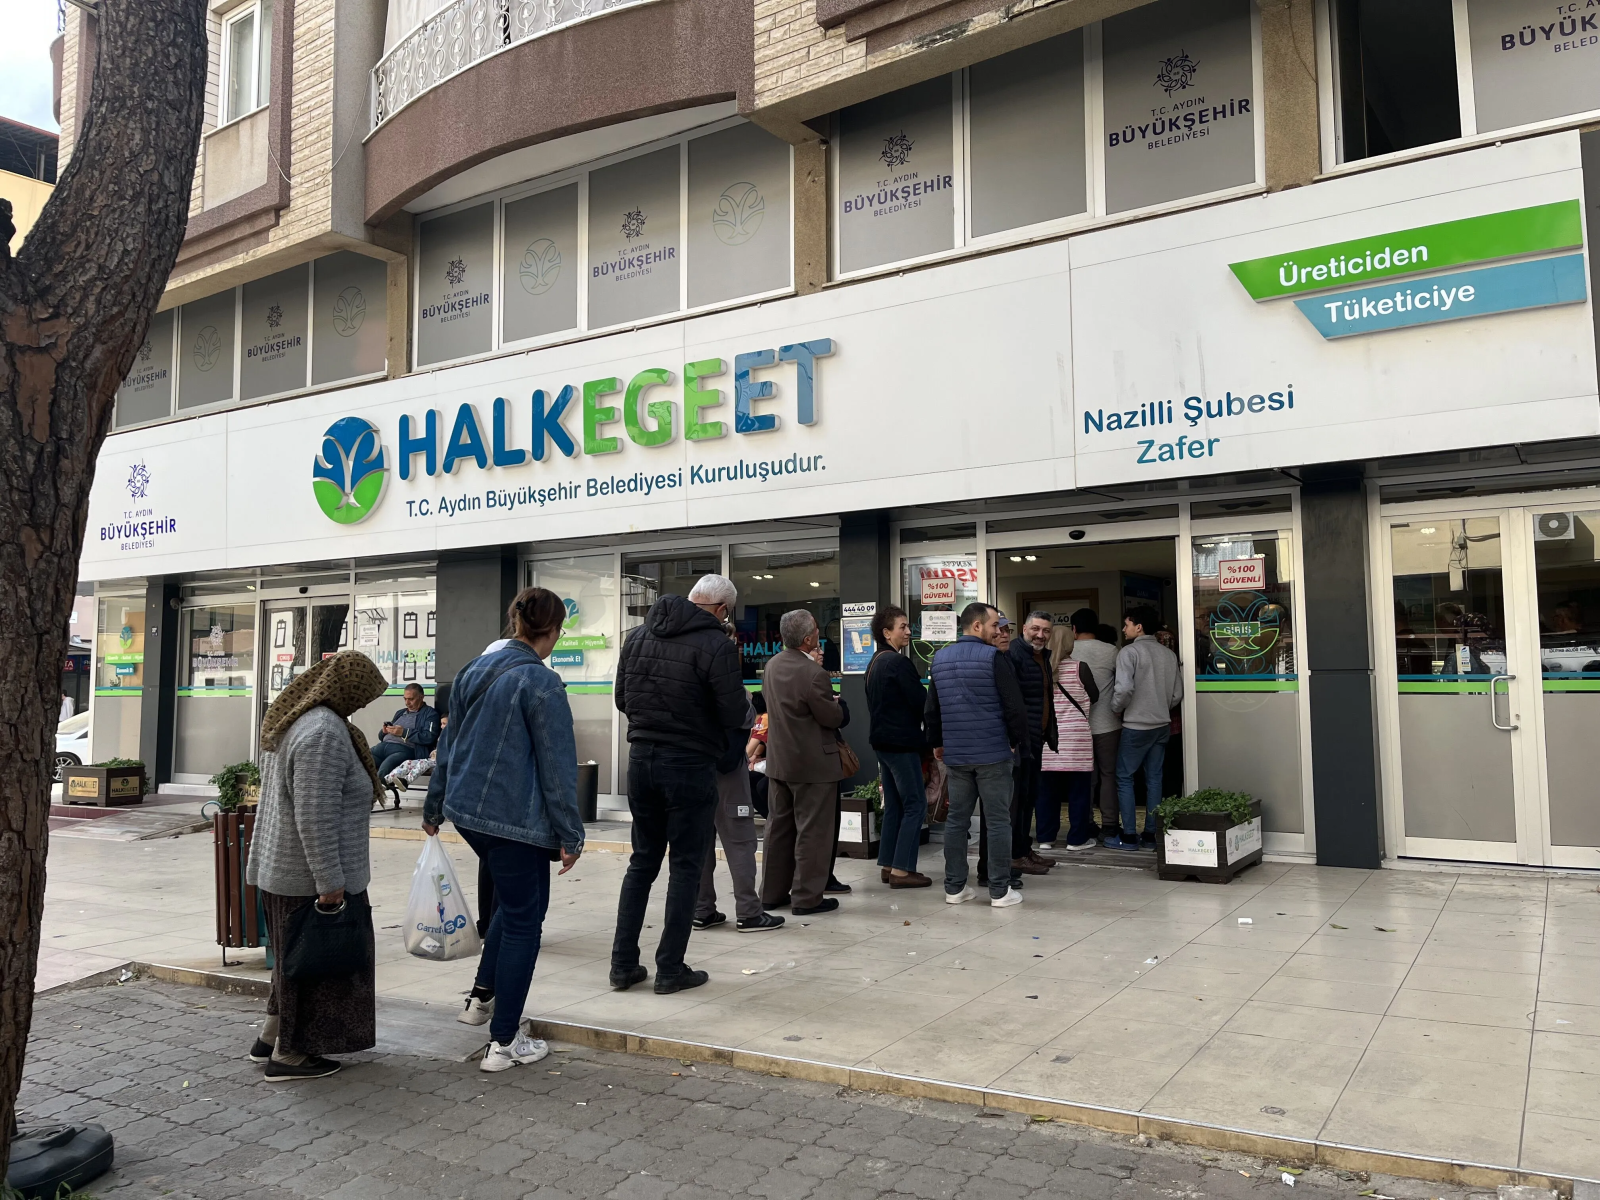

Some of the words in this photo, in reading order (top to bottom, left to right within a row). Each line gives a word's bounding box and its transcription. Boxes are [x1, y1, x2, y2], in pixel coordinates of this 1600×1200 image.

[1556, 3, 1581, 15] T.C.
[1501, 13, 1599, 51] BÜYÜK
[1554, 35, 1599, 53] BELED
[1151, 106, 1169, 117] T.C.
[1173, 96, 1205, 111] AYDIN
[1109, 98, 1251, 147] BÜYÜKŞEHİR
[1148, 126, 1210, 150] BELEDİYESİ
[877, 179, 891, 188] T.C.
[893, 172, 918, 185] AYDIN
[844, 174, 953, 214] BÜYÜKŞEHİR
[873, 198, 922, 217] BELEDİYESİ
[631, 243, 650, 253] AYDIN
[593, 246, 676, 278] BÜYÜKŞEHİR
[1279, 245, 1428, 287] Üreticiden
[615, 266, 652, 281] BELEDİYESİ
[453, 289, 469, 298] AYDIN
[422, 292, 490, 319] BÜYÜKŞEHİR
[1324, 284, 1475, 323] Tüketiciye
[440, 310, 471, 323] BELEDİYESİ
[271, 332, 285, 340] AYDIN
[247, 335, 302, 358] BÜYÜKŞEHİR
[261, 351, 286, 362] BELEDİYESİ
[122, 368, 167, 389] BÜYÜKŞEHİR
[398, 337, 837, 481] HALKEGEET
[1084, 399, 1173, 434] Nazilli
[1183, 383, 1294, 427] Şubesi
[1136, 435, 1221, 465] Zafer
[406, 499, 433, 518] T.C.
[438, 493, 481, 516] Aydın
[486, 480, 581, 509] Büyükşehir
[586, 467, 683, 499] Belediyesi
[690, 453, 827, 485] Kuruluşudur.
[124, 511, 134, 519] T.C.
[135, 508, 153, 517] AYDIN
[100, 515, 177, 541] BÜYÜKŞEHİR
[121, 538, 155, 551] BELEDİYESİ
[1227, 565, 1256, 574] %100
[928, 582, 949, 590] %100
[1223, 574, 1261, 584] GÜVENLİ
[924, 591, 953, 599] GÜVENLİ
[584, 638, 604, 647] Hijyenik
[377, 648, 436, 664] HALKEGEE
[552, 655, 575, 663] Ekonomik
